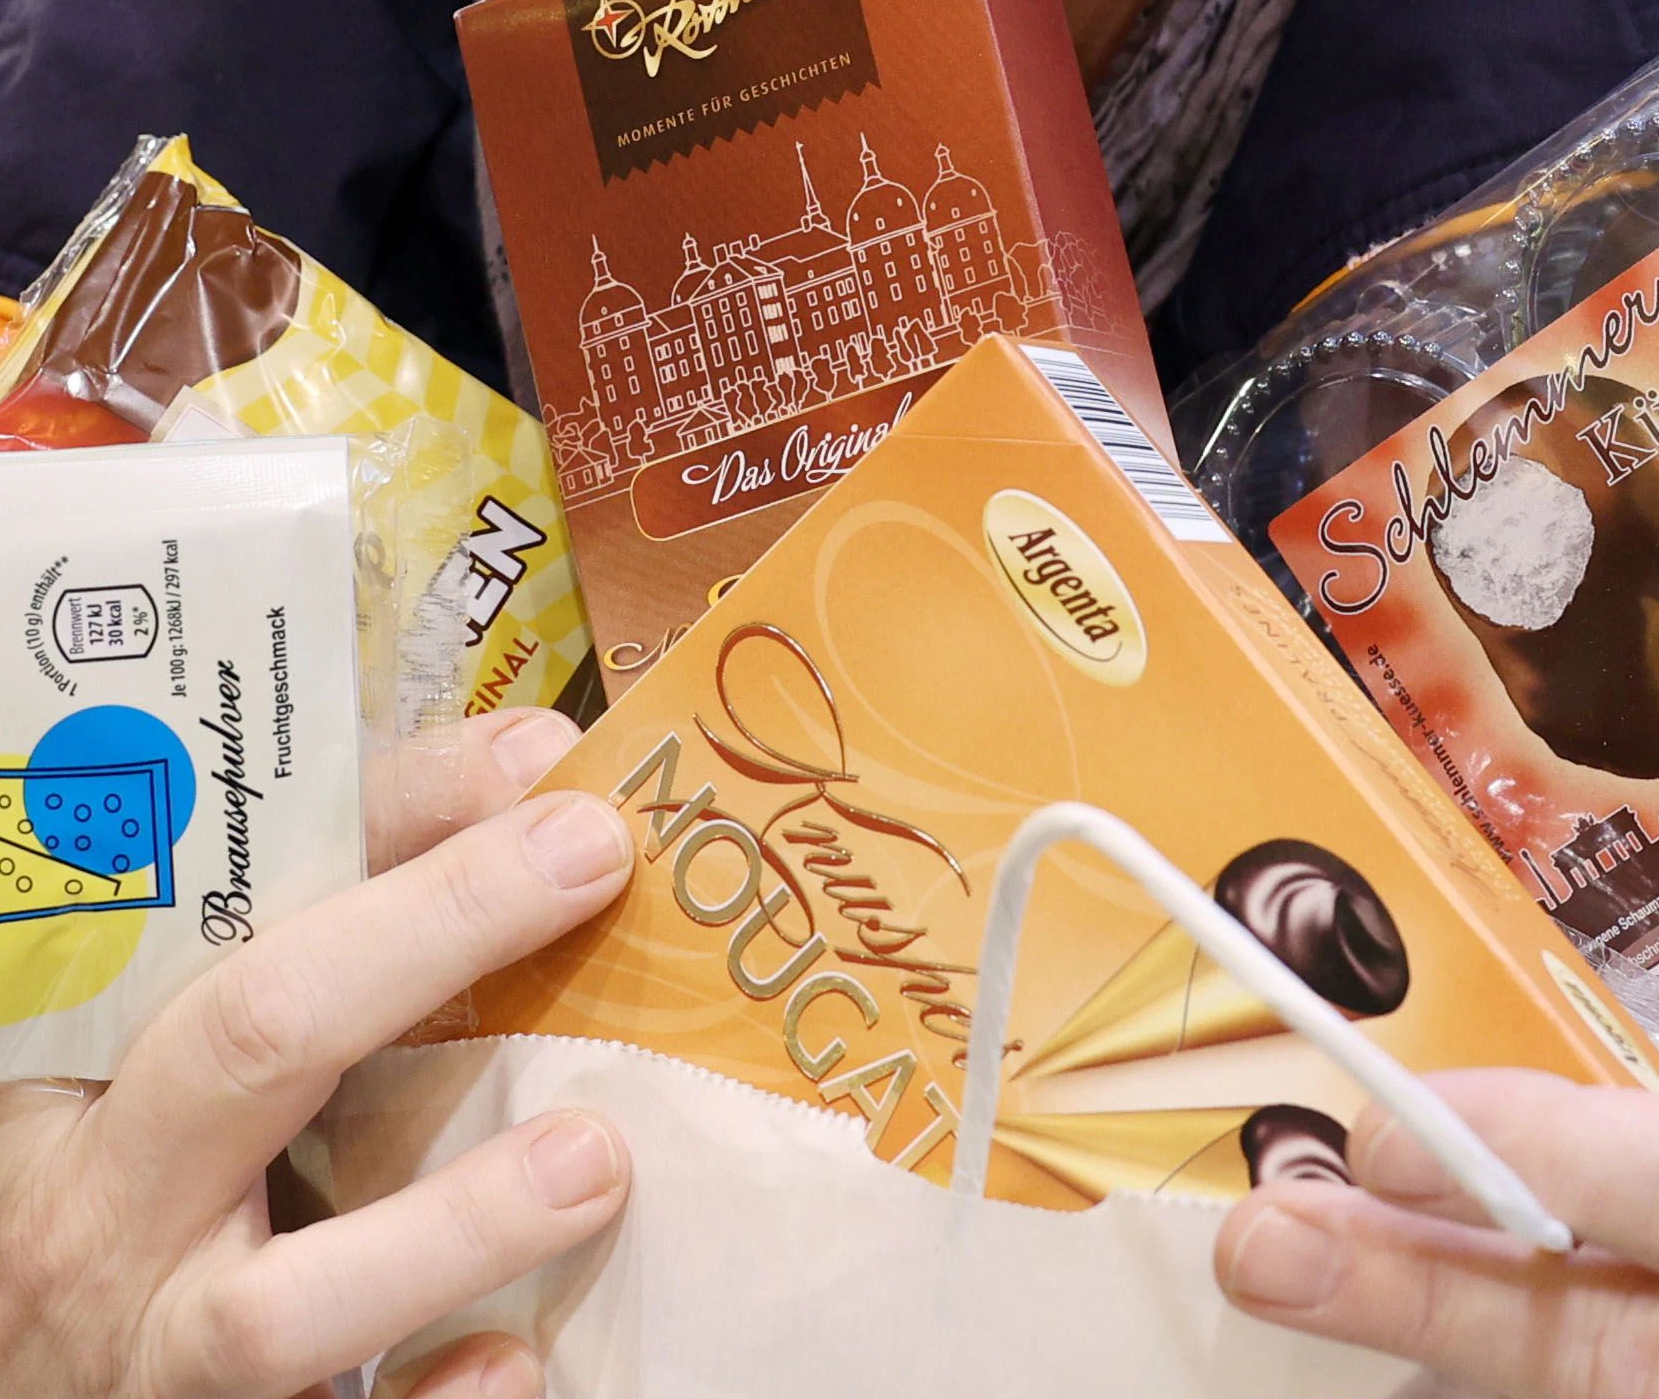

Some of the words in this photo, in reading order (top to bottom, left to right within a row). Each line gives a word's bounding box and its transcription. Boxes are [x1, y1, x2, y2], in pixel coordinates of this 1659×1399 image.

[617, 108, 695, 148] MOMENTE
[702, 95, 733, 117] FÜR
[739, 53, 852, 102] GESCHICHTEN
[681, 451, 775, 505] Das
[162, 539, 178, 564] kcal
[164, 567, 180, 589] 297
[1008, 527, 1120, 643] Argenta
[24, 612, 43, 625] g)
[87, 604, 103, 618] kJ
[106, 600, 122, 627] kcal
[166, 601, 182, 641] 1268kJ
[68, 597, 84, 655] Brennwert
[89, 621, 104, 645] 127
[109, 630, 123, 646] 30
[134, 627, 148, 636] 2
[25, 629, 45, 650] (10
[172, 645, 188, 656] g:
[34, 649, 70, 692] Portion
[170, 660, 185, 681] 100
[463, 637, 539, 718] GINAL
[69, 683, 78, 696] 1
[172, 684, 186, 697] Je
[267, 605, 294, 779] Fruchtgeschmack
[1359, 639, 1516, 871] www.schlemmer-kuesse.de
[199, 659, 264, 946] Brausepulver
[604, 731, 966, 1169] NOUGAT
